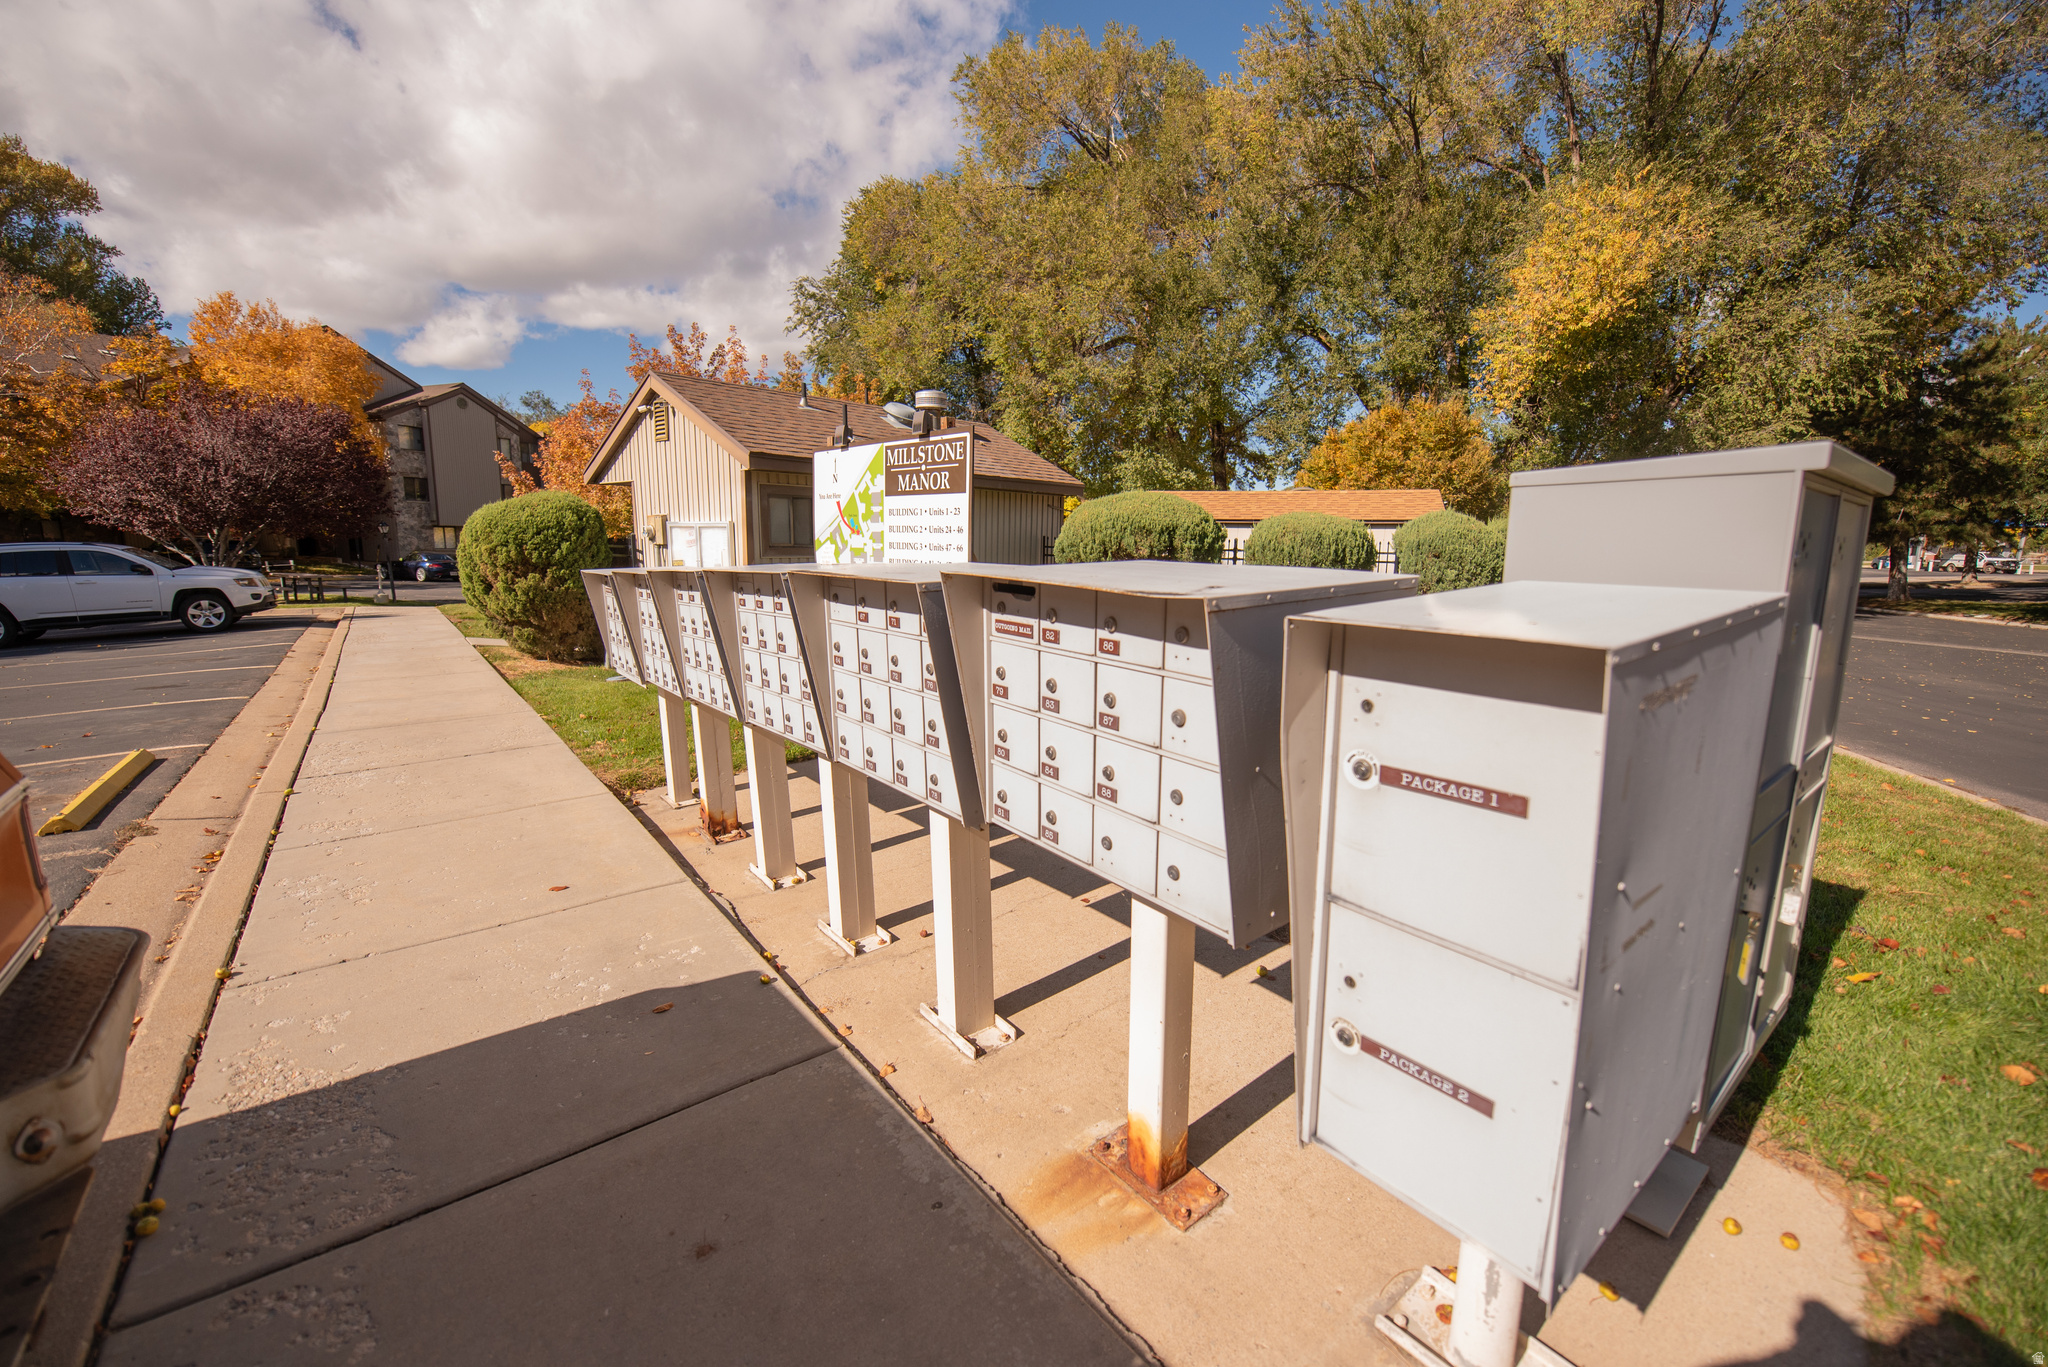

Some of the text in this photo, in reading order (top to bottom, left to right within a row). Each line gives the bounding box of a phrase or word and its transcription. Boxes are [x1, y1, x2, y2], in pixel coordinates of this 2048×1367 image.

[886, 441, 964, 466] MILLSTONE
[832, 474, 838, 484] N
[898, 471, 950, 492] MANOR
[888, 508, 918, 516] BUILDING
[928, 507, 944, 516] Units
[954, 507, 960, 515] 23
[928, 525, 944, 533] Units
[956, 526, 963, 534] 46
[888, 542, 918, 550] BUILDING
[928, 543, 944, 551] Units
[995, 622, 1032, 635] OUTGOING MAIL
[1045, 630, 1055, 640] 82
[1103, 641, 1114, 651] 86
[995, 686, 1004, 695] 79
[1045, 699, 1055, 709] 83
[1103, 715, 1113, 726] 87
[997, 748, 1005, 757] 80
[1044, 766, 1054, 776] 84
[1101, 787, 1111, 798] 88
[1400, 772, 1499, 807] PACKAGE 1
[997, 808, 1004, 817] 81
[1044, 829, 1054, 839] 85
[1379, 1048, 1469, 1103] PACKAGE 2
